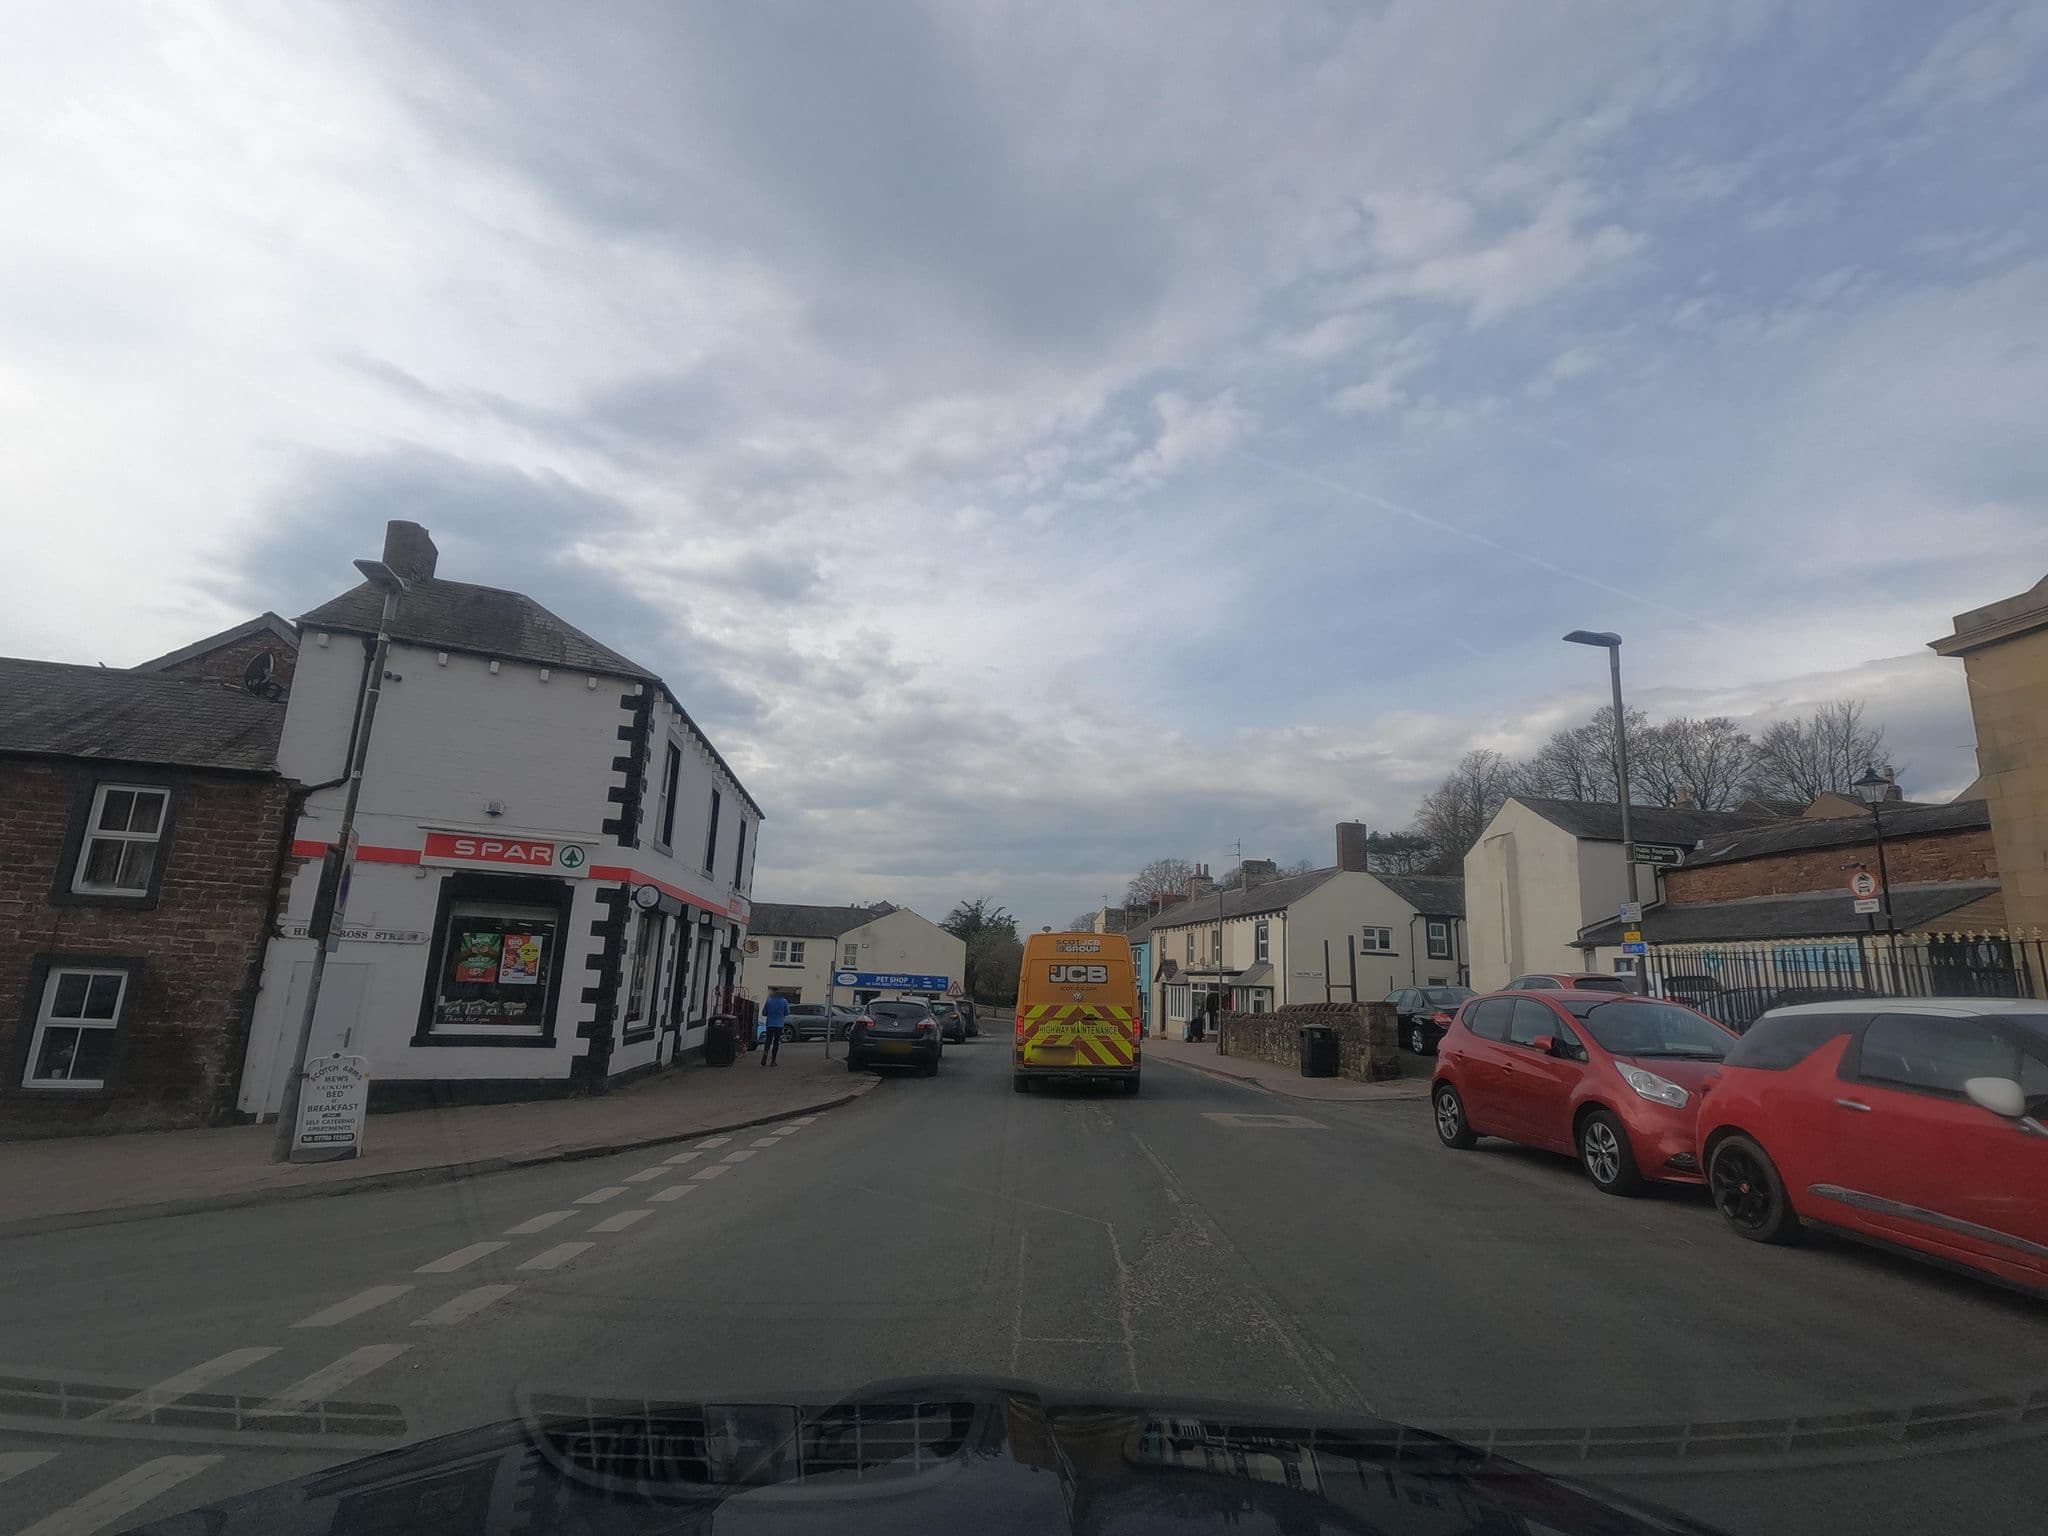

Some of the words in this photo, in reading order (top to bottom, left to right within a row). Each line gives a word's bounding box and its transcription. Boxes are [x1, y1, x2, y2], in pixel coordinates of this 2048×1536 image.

[454, 839, 550, 862] SPAR
[889, 976, 909, 984] SHOP
[1050, 965, 1107, 983] JCB
[1039, 1025, 1069, 1035] HIGHWAY
[1071, 1025, 1119, 1035] MAINTENANCE
[311, 1065, 339, 1081] SCOTCH
[343, 1065, 363, 1080] ARMS
[307, 1103, 358, 1112] BREAKFAST
